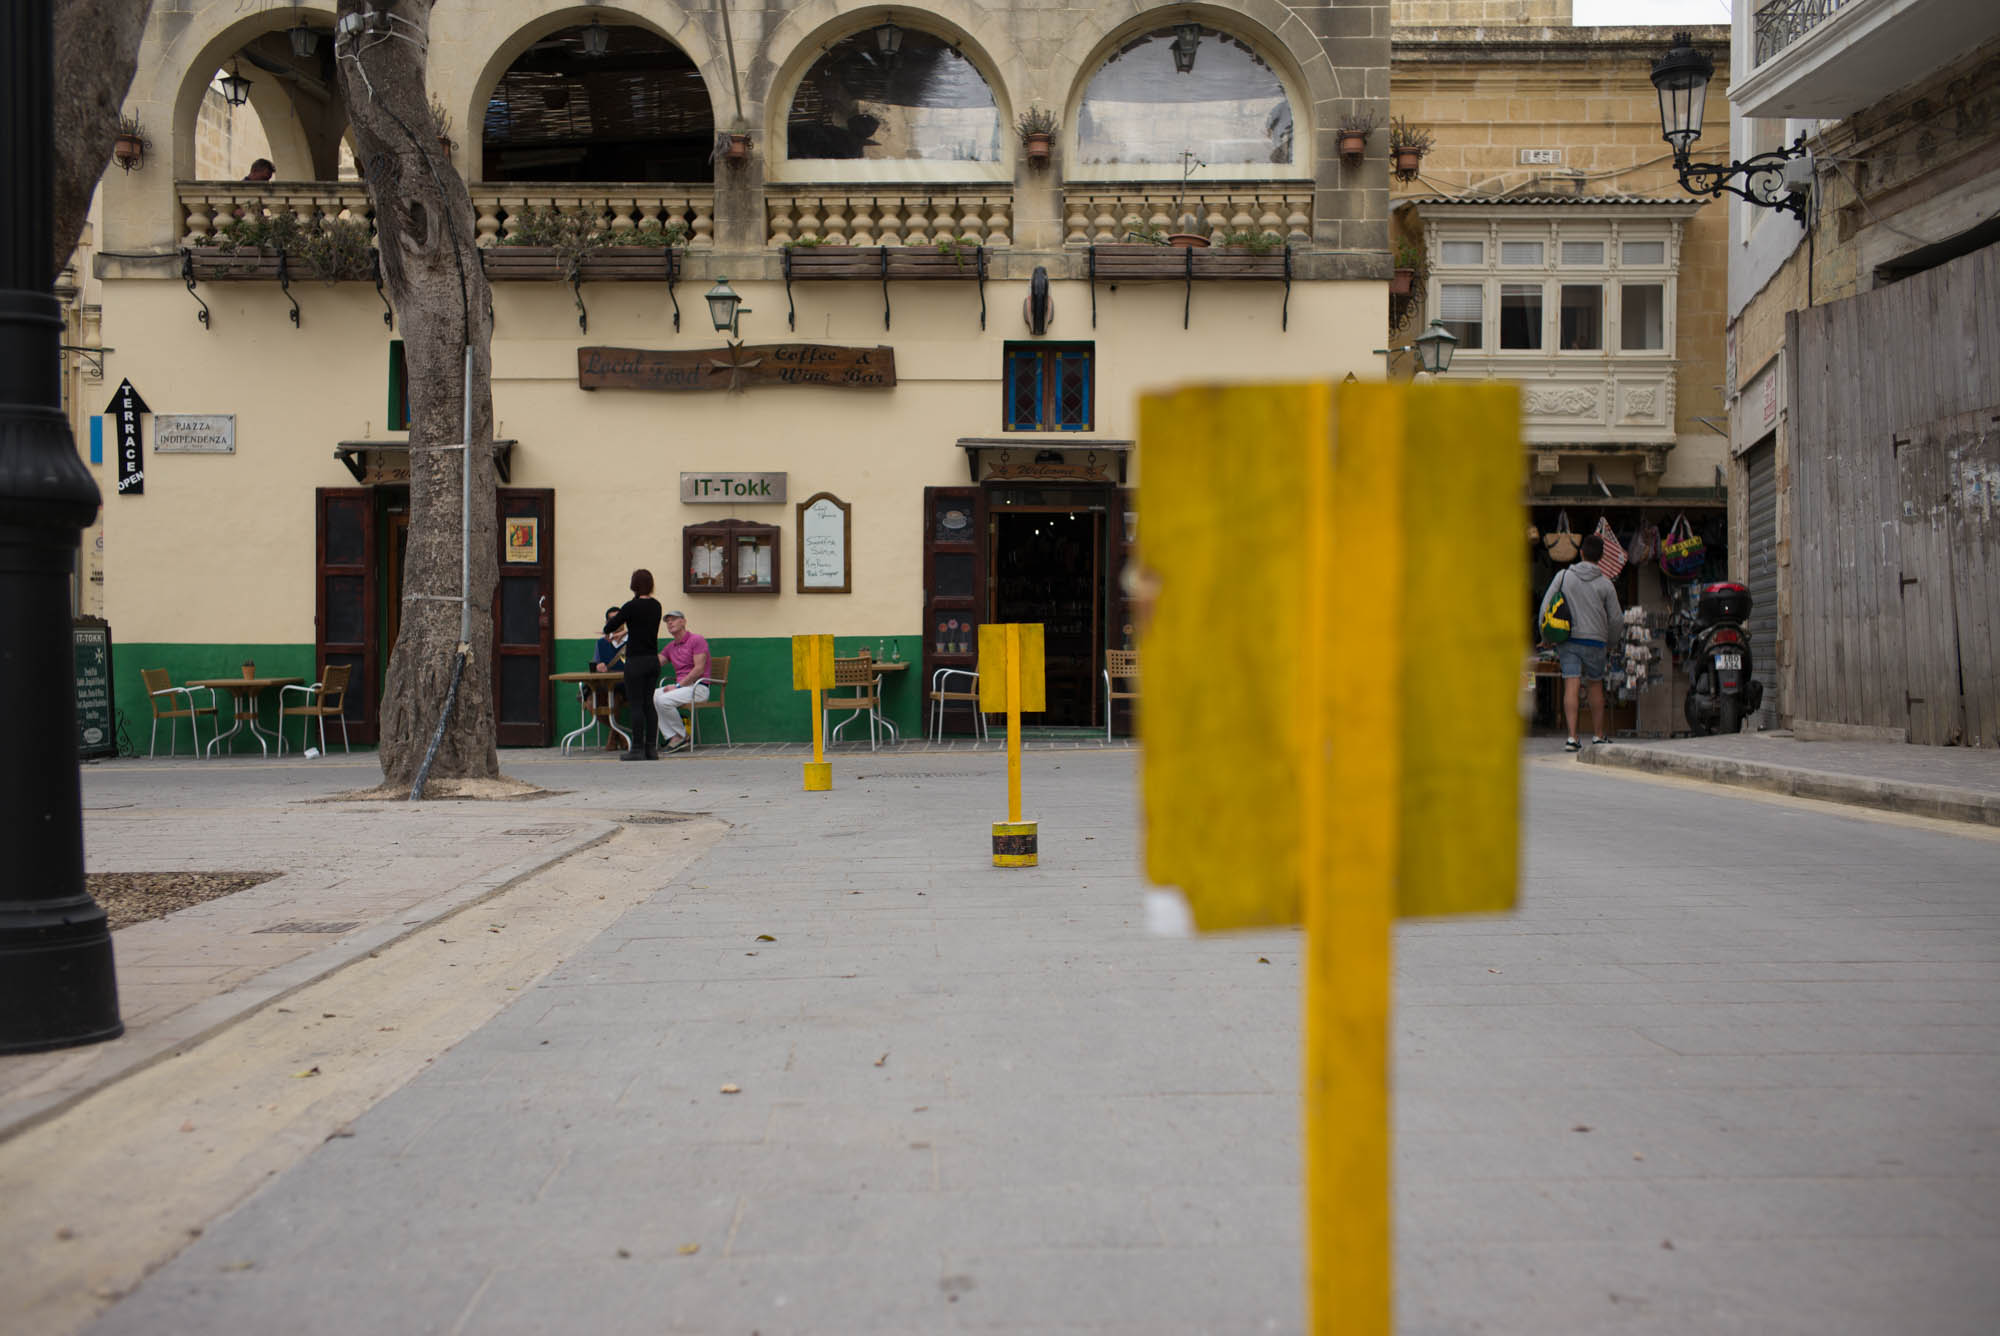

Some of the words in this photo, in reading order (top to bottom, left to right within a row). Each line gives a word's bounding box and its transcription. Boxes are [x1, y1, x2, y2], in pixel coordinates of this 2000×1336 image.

[774, 346, 836, 364] Coffee
[584, 351, 643, 375] Local
[648, 361, 702, 385] Food
[779, 367, 830, 382] Wine
[841, 367, 884, 383] Bar
[121, 385, 136, 472] TERRACE
[160, 435, 227, 444] INDIPENDENZA
[117, 470, 144, 491] OPEN
[694, 479, 772, 496] IT-Tokk
[76, 633, 103, 643] IT-TOKK
